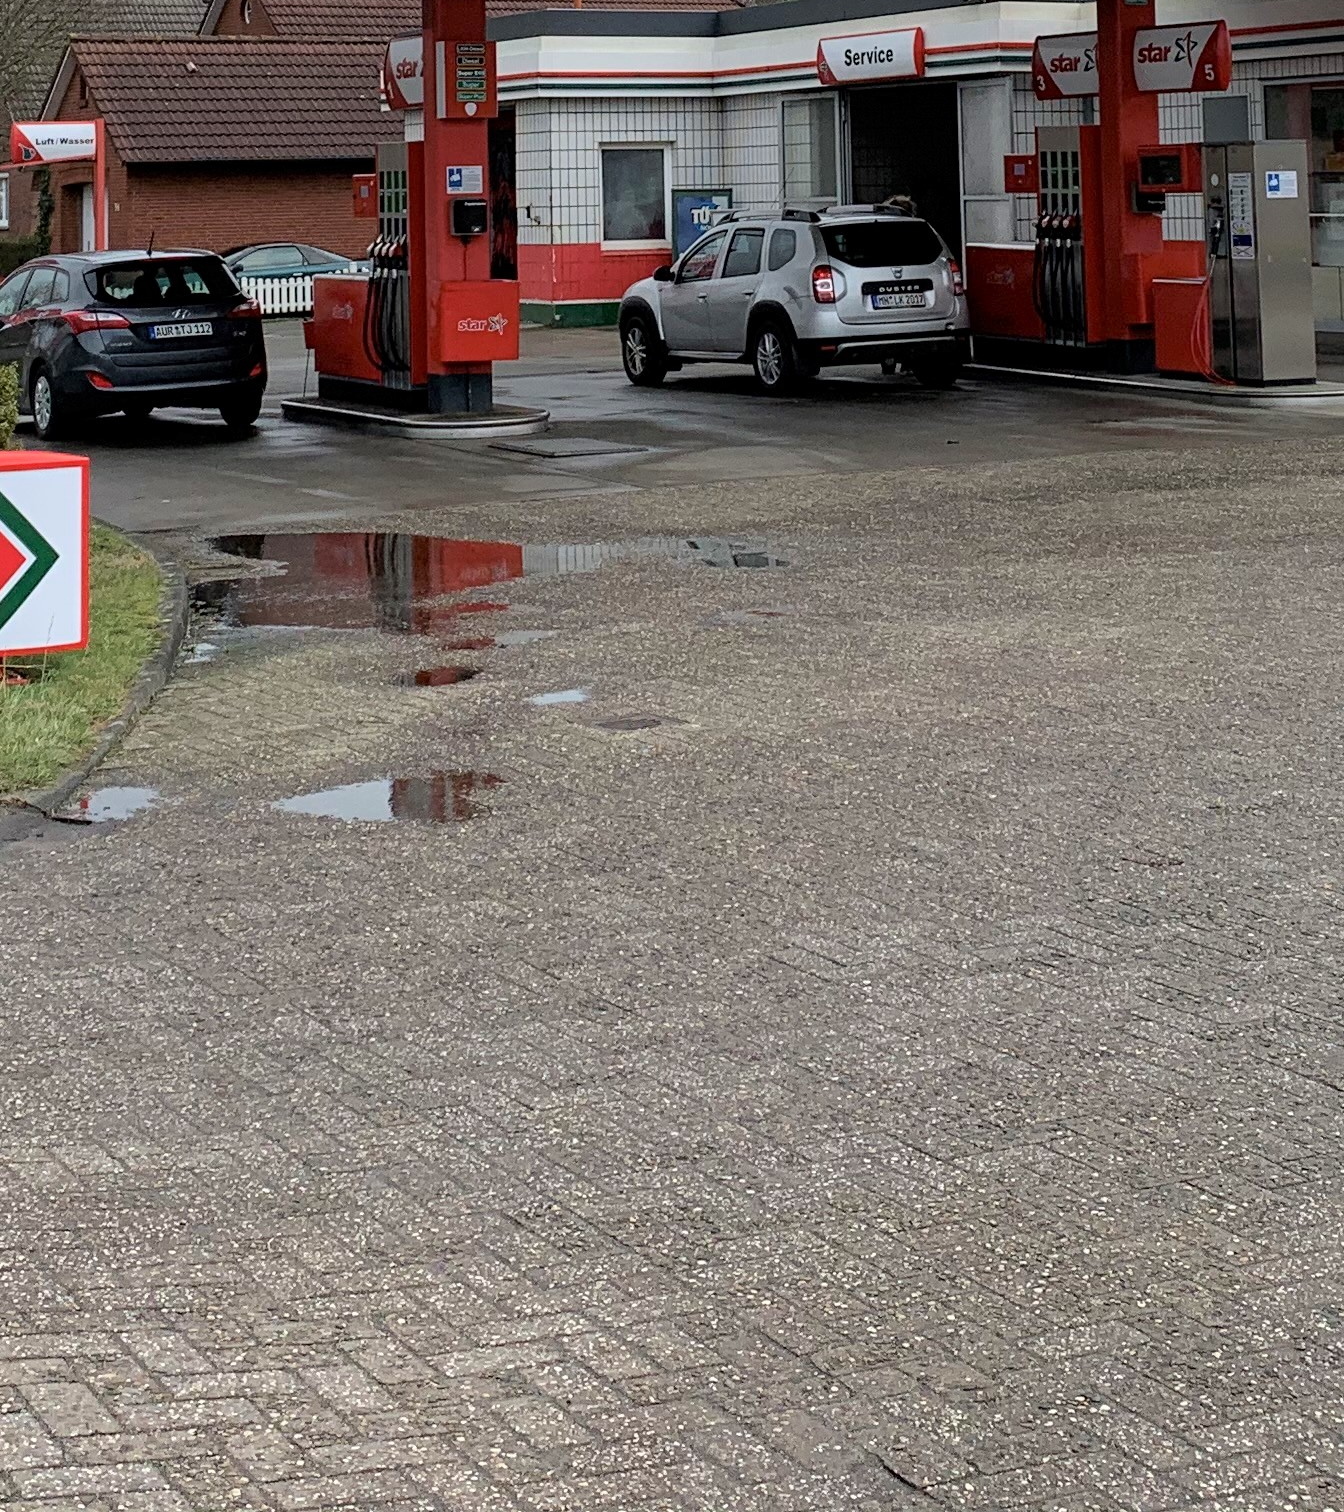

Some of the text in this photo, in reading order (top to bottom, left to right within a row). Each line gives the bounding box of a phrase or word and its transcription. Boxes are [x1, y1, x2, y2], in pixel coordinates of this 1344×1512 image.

[844, 46, 894, 67] Service
[1049, 51, 1081, 73] star
[1138, 42, 1171, 64] star
[396, 57, 419, 80] star
[1204, 64, 1215, 81] 5
[1036, 76, 1046, 91] 3
[458, 318, 487, 332] star
